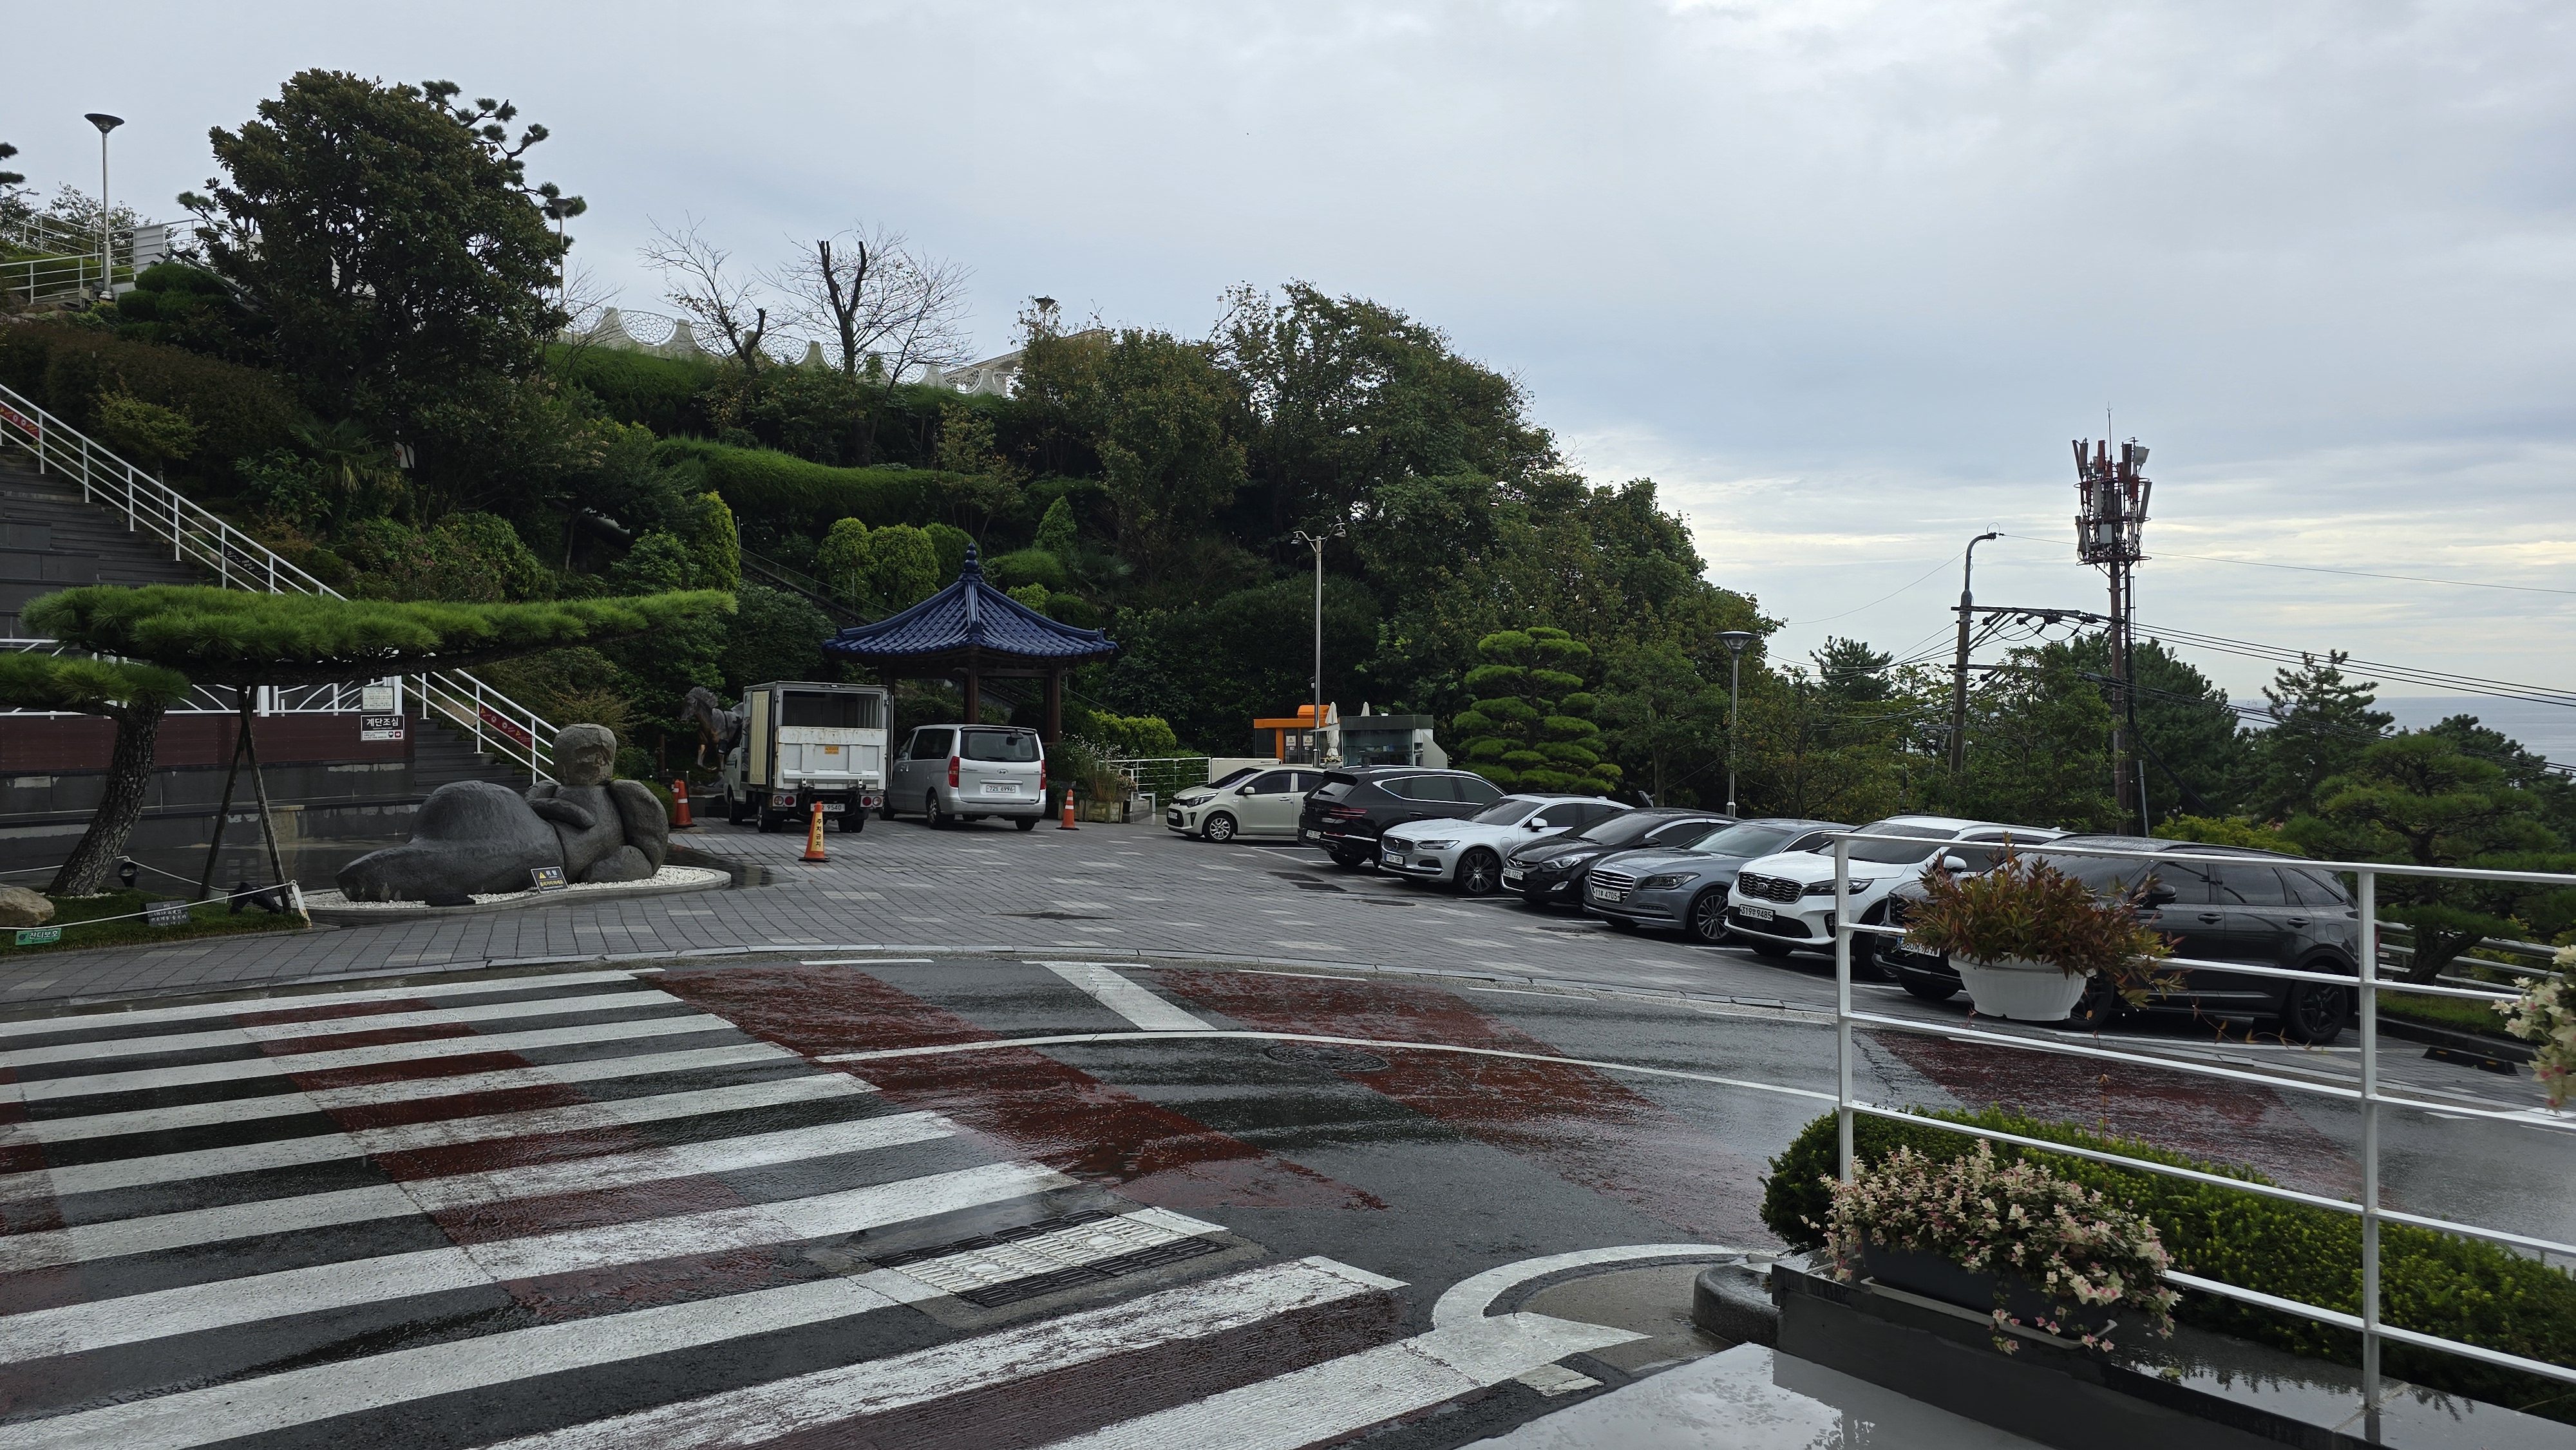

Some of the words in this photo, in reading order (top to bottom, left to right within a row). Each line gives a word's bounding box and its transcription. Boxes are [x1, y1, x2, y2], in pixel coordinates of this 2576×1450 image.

[366, 717, 399, 727] 계단조심
[1604, 890, 1617, 900] 4705
[1756, 909, 1772, 919] 9485
[29, 930, 59, 939] 잔디보호
